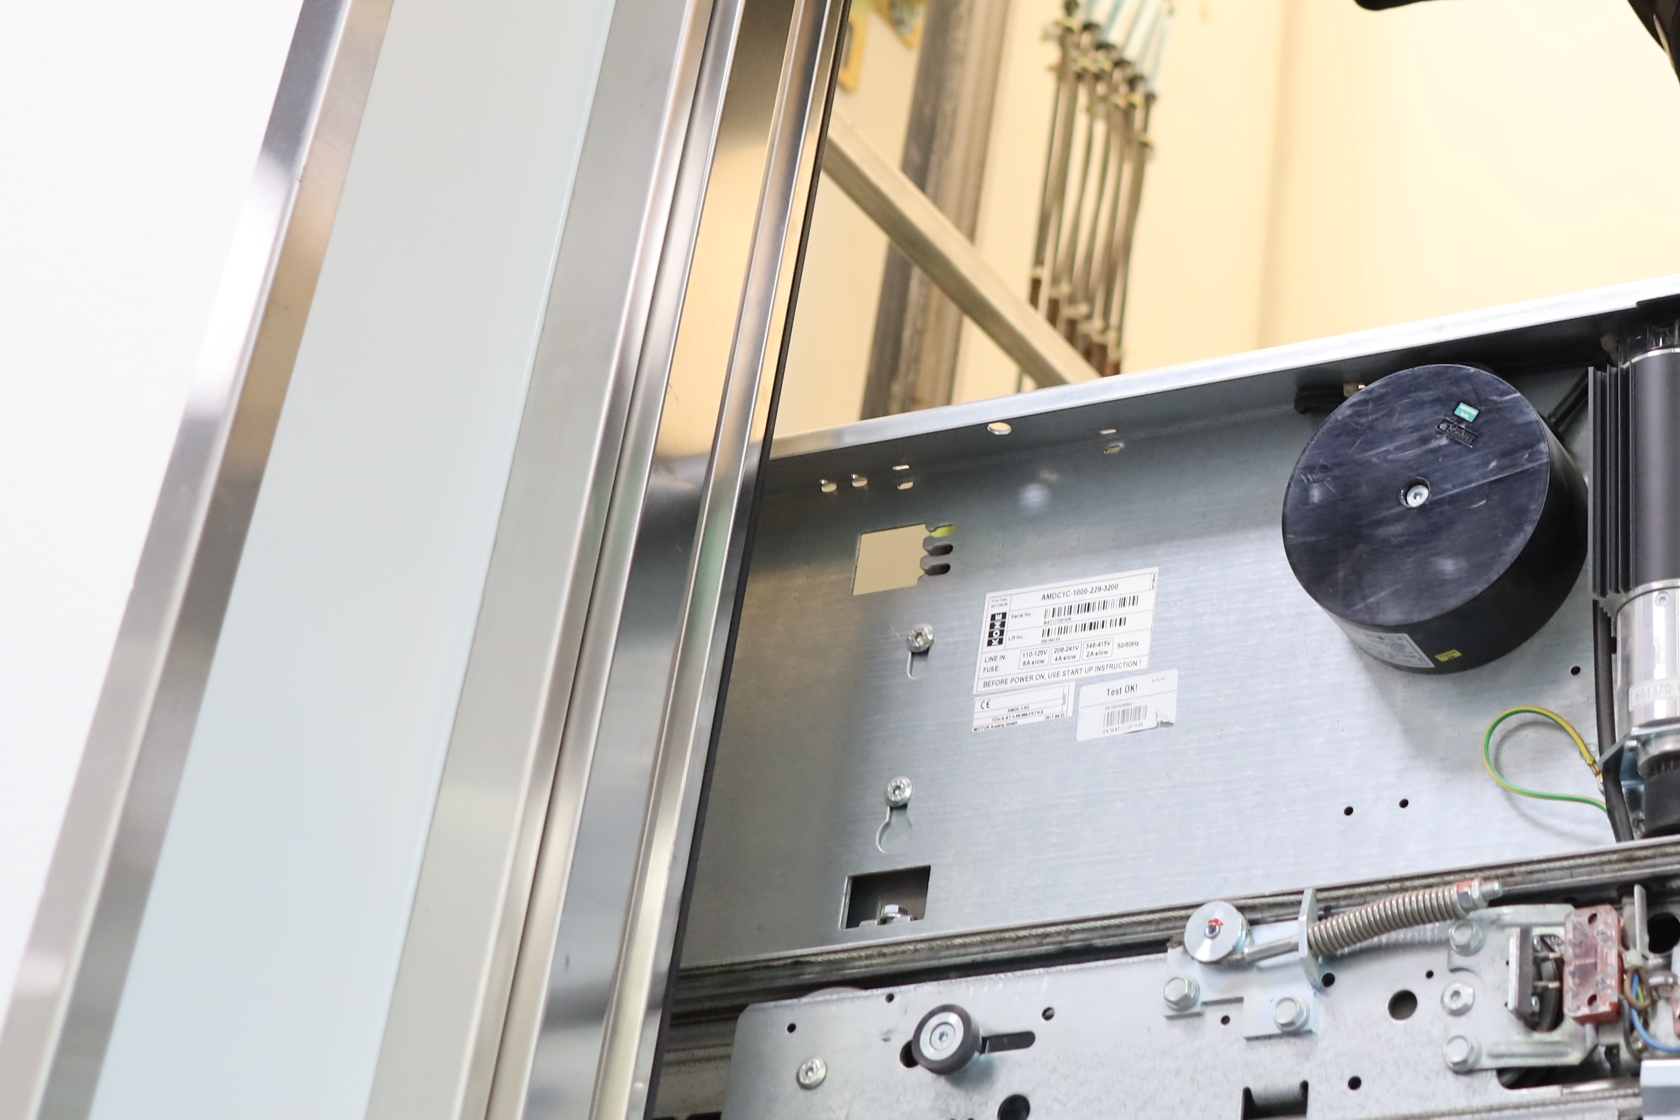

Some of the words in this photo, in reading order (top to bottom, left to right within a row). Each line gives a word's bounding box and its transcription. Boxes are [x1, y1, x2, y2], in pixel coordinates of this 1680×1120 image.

[1041, 583, 1119, 601] AMDC1C-1000-229-3200
[989, 612, 1005, 646] KONE
[1117, 641, 1140, 649] 50/60Hz
[984, 655, 998, 663] LINE
[1022, 649, 1047, 658] 110-125V
[982, 678, 1009, 688] BEFORE
[1010, 674, 1034, 684] POWER
[1048, 670, 1060, 679] USE
[1062, 667, 1083, 677] START
[1084, 665, 1093, 674] UP
[1095, 660, 1138, 672] INSTRUCTION
[1106, 687, 1122, 697] Test
[1124, 683, 1138, 694] OK!
